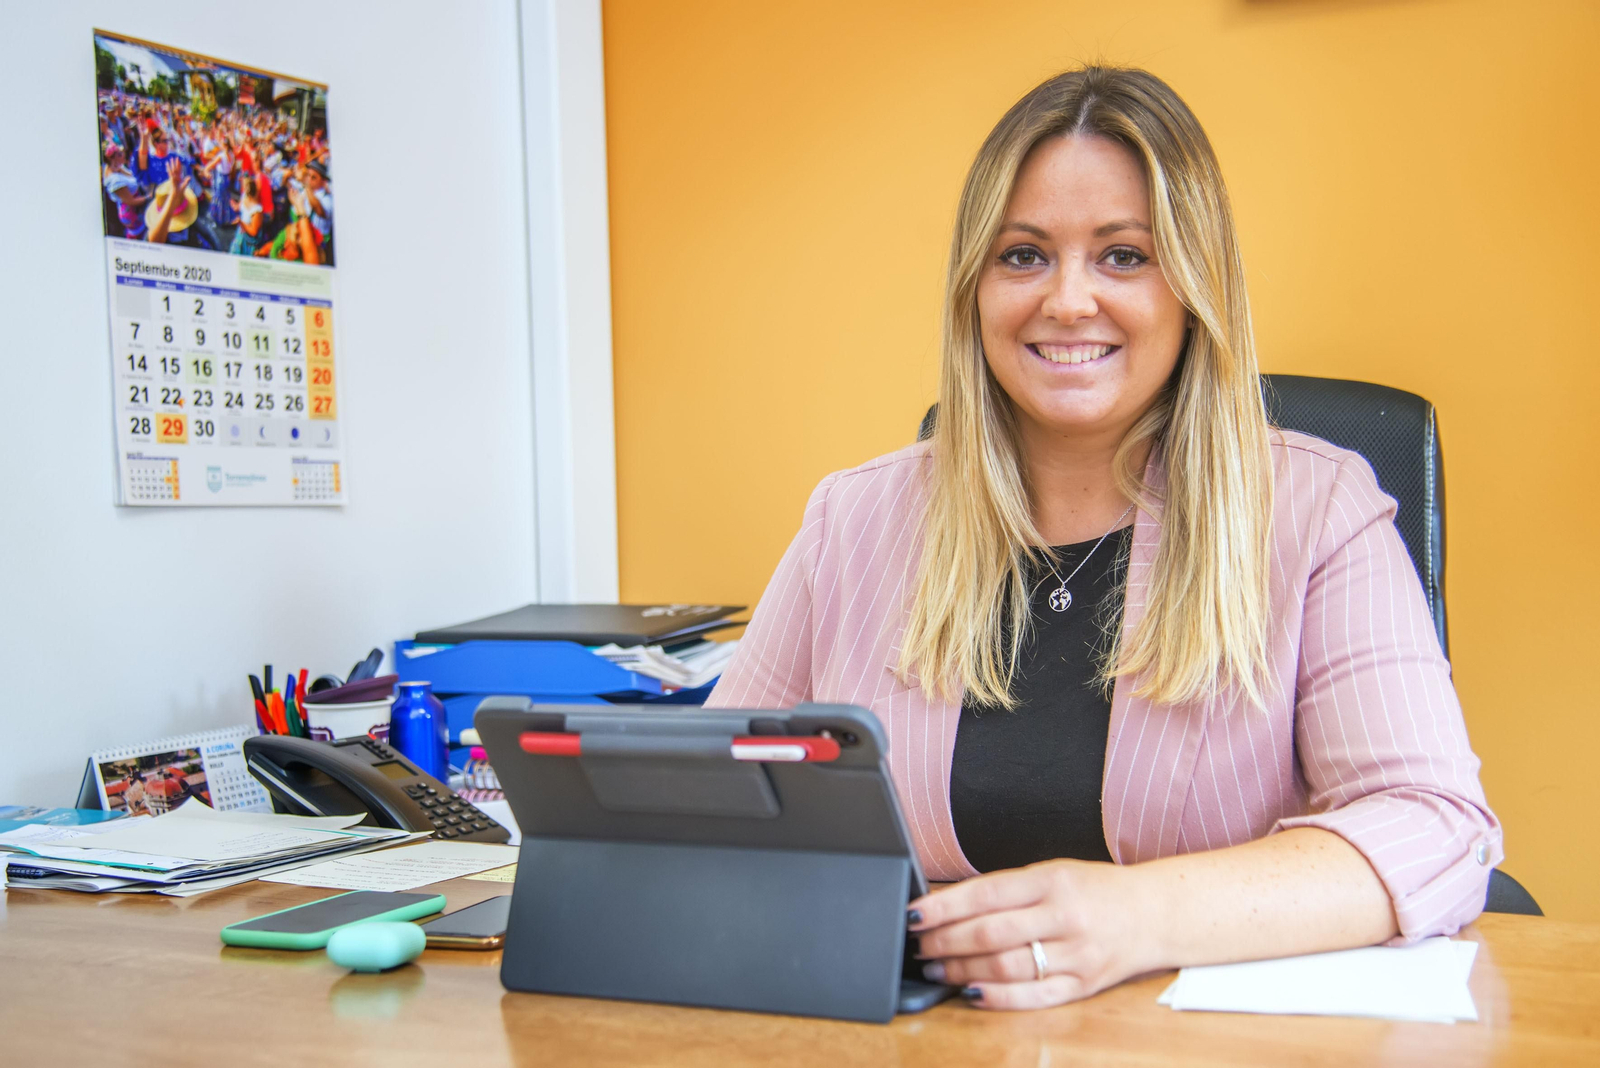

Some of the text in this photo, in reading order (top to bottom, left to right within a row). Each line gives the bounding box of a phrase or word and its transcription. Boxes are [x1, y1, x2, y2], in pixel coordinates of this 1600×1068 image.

[115, 257, 212, 282] Septiembre 2020
[163, 295, 324, 328] 1 2 3 4 5 6
[130, 322, 330, 357] 7 8 9 10 11 12 13
[127, 354, 332, 385] 14 15 16 17 18 19 20
[130, 385, 332, 414] 21 22 23 24 25 26 27
[130, 417, 214, 437] 28 29 30
